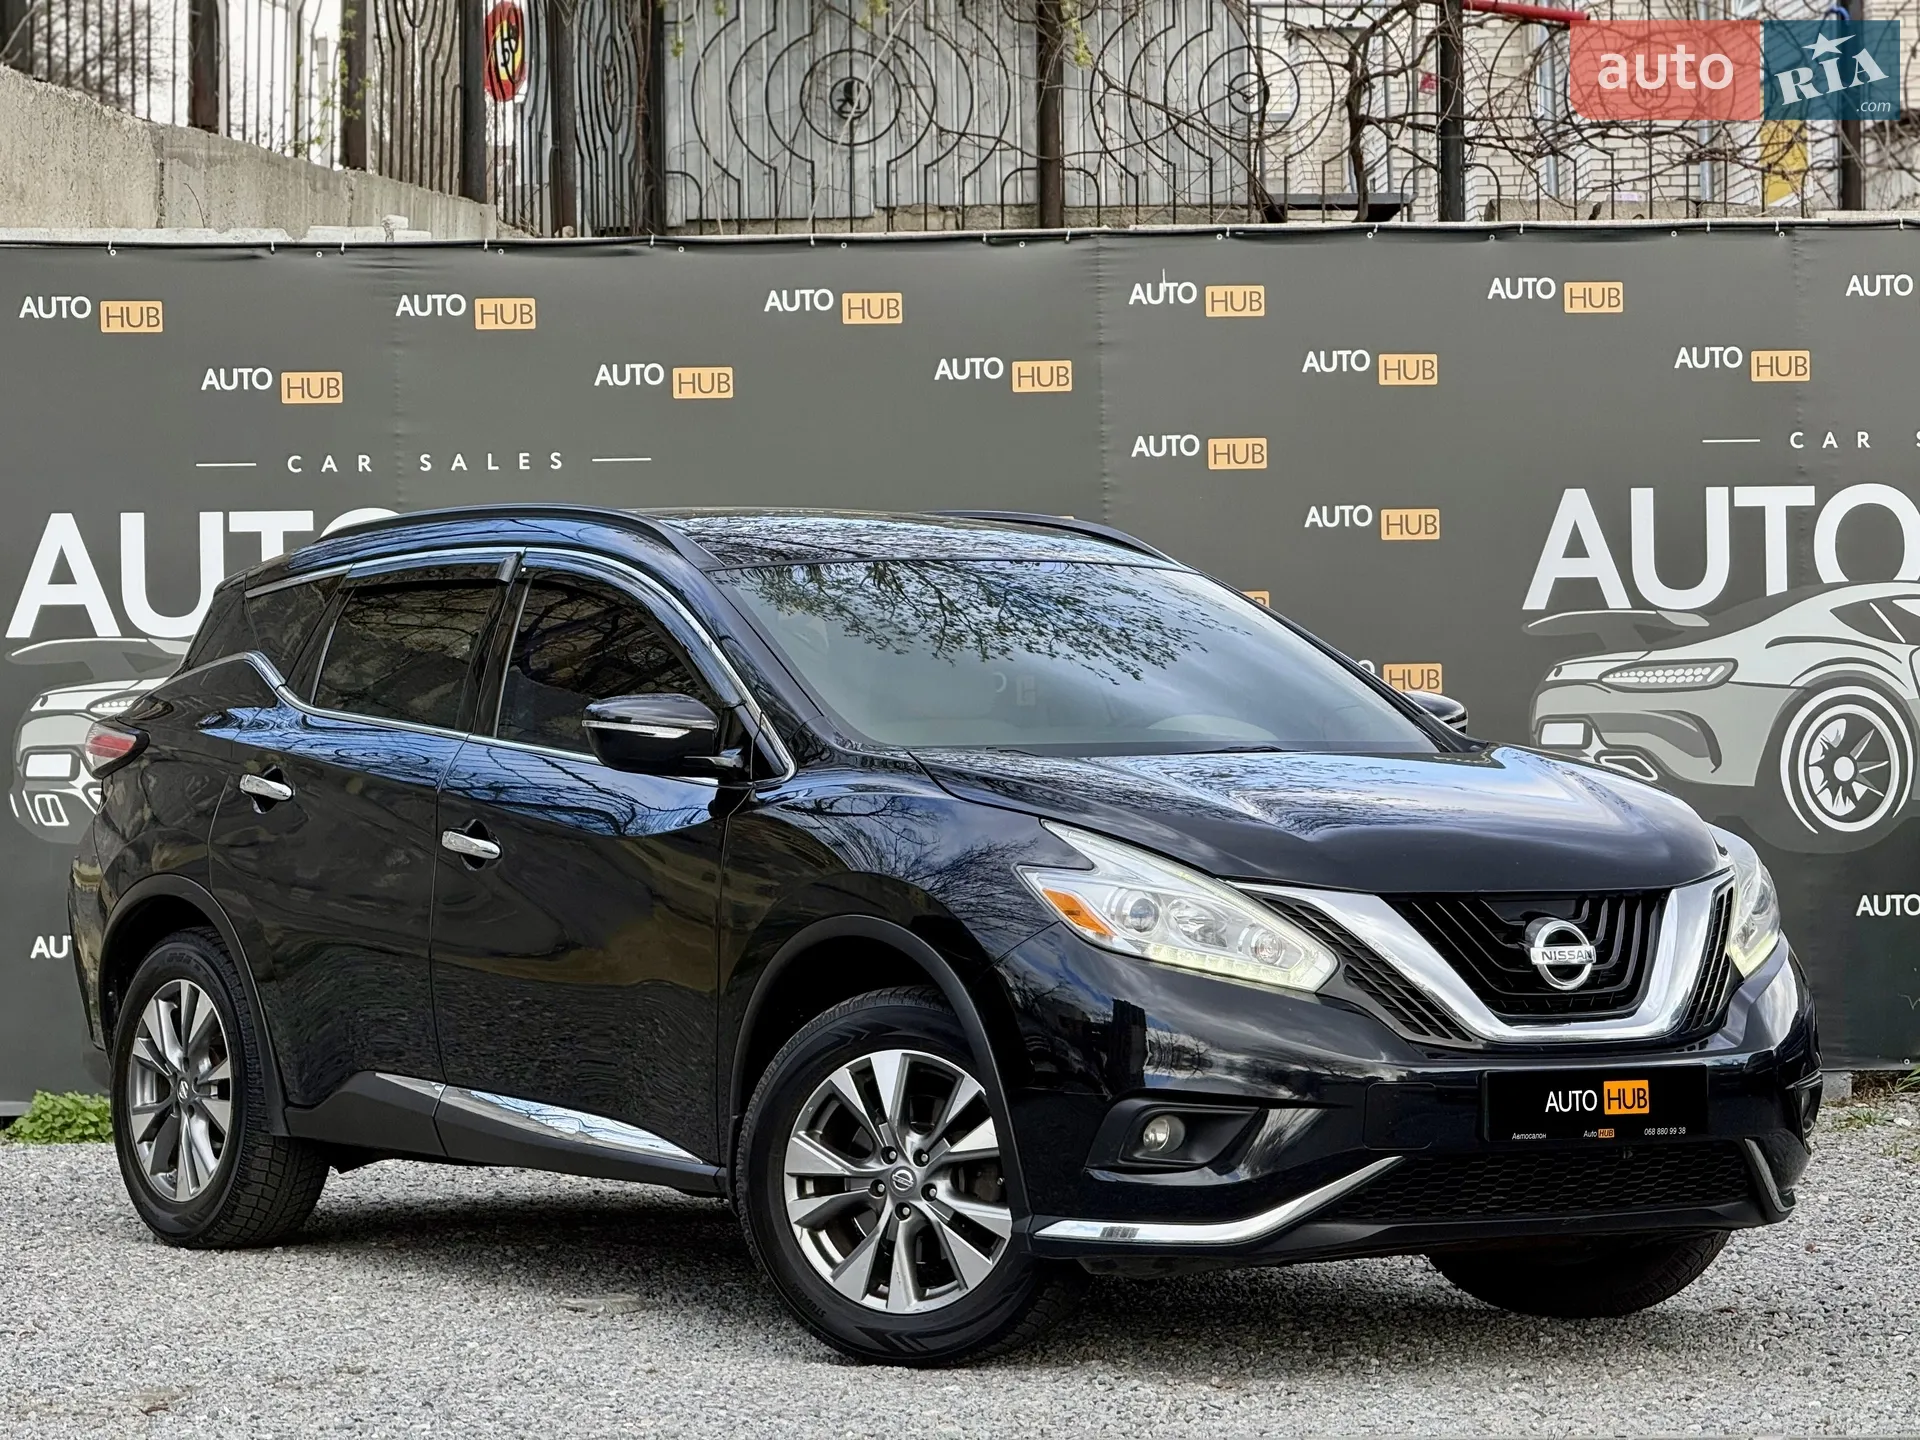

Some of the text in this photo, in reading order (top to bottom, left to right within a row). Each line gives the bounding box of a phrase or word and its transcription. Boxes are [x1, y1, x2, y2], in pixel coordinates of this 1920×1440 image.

[1128, 281, 1264, 313] AUTO HUB
[1487, 277, 1622, 310] AUTO HUB
[1845, 273, 1914, 297] AUTO
[18, 295, 162, 329] AUTO HUB
[395, 293, 535, 326] AUTO HUB
[763, 288, 901, 321] AUTO HUB
[934, 356, 1071, 389] AUTO HUB
[1301, 349, 1436, 382] AUTO HUB
[1673, 346, 1809, 378] AUTO HUB
[200, 367, 342, 400] AUTO HUB
[593, 362, 732, 395] AUTO HUB
[1131, 434, 1266, 466] AUTO HUB
[1789, 431, 1872, 449] CAR
[287, 451, 564, 473] CAR SALES
[1304, 504, 1439, 537] AUTO HUB
[1522, 483, 1920, 610] AUTO
[5, 508, 400, 638] AUT
[1386, 667, 1441, 691] HUB
[1855, 893, 1920, 917] AUTO
[1541, 950, 1593, 961] NISSAN
[1545, 1086, 1648, 1113] AUTO HUB
[1511, 1132, 1547, 1140] Автосалон
[1583, 1129, 1614, 1138] Auto HUB
[1643, 1126, 1686, 1136] 068 880 99 38
